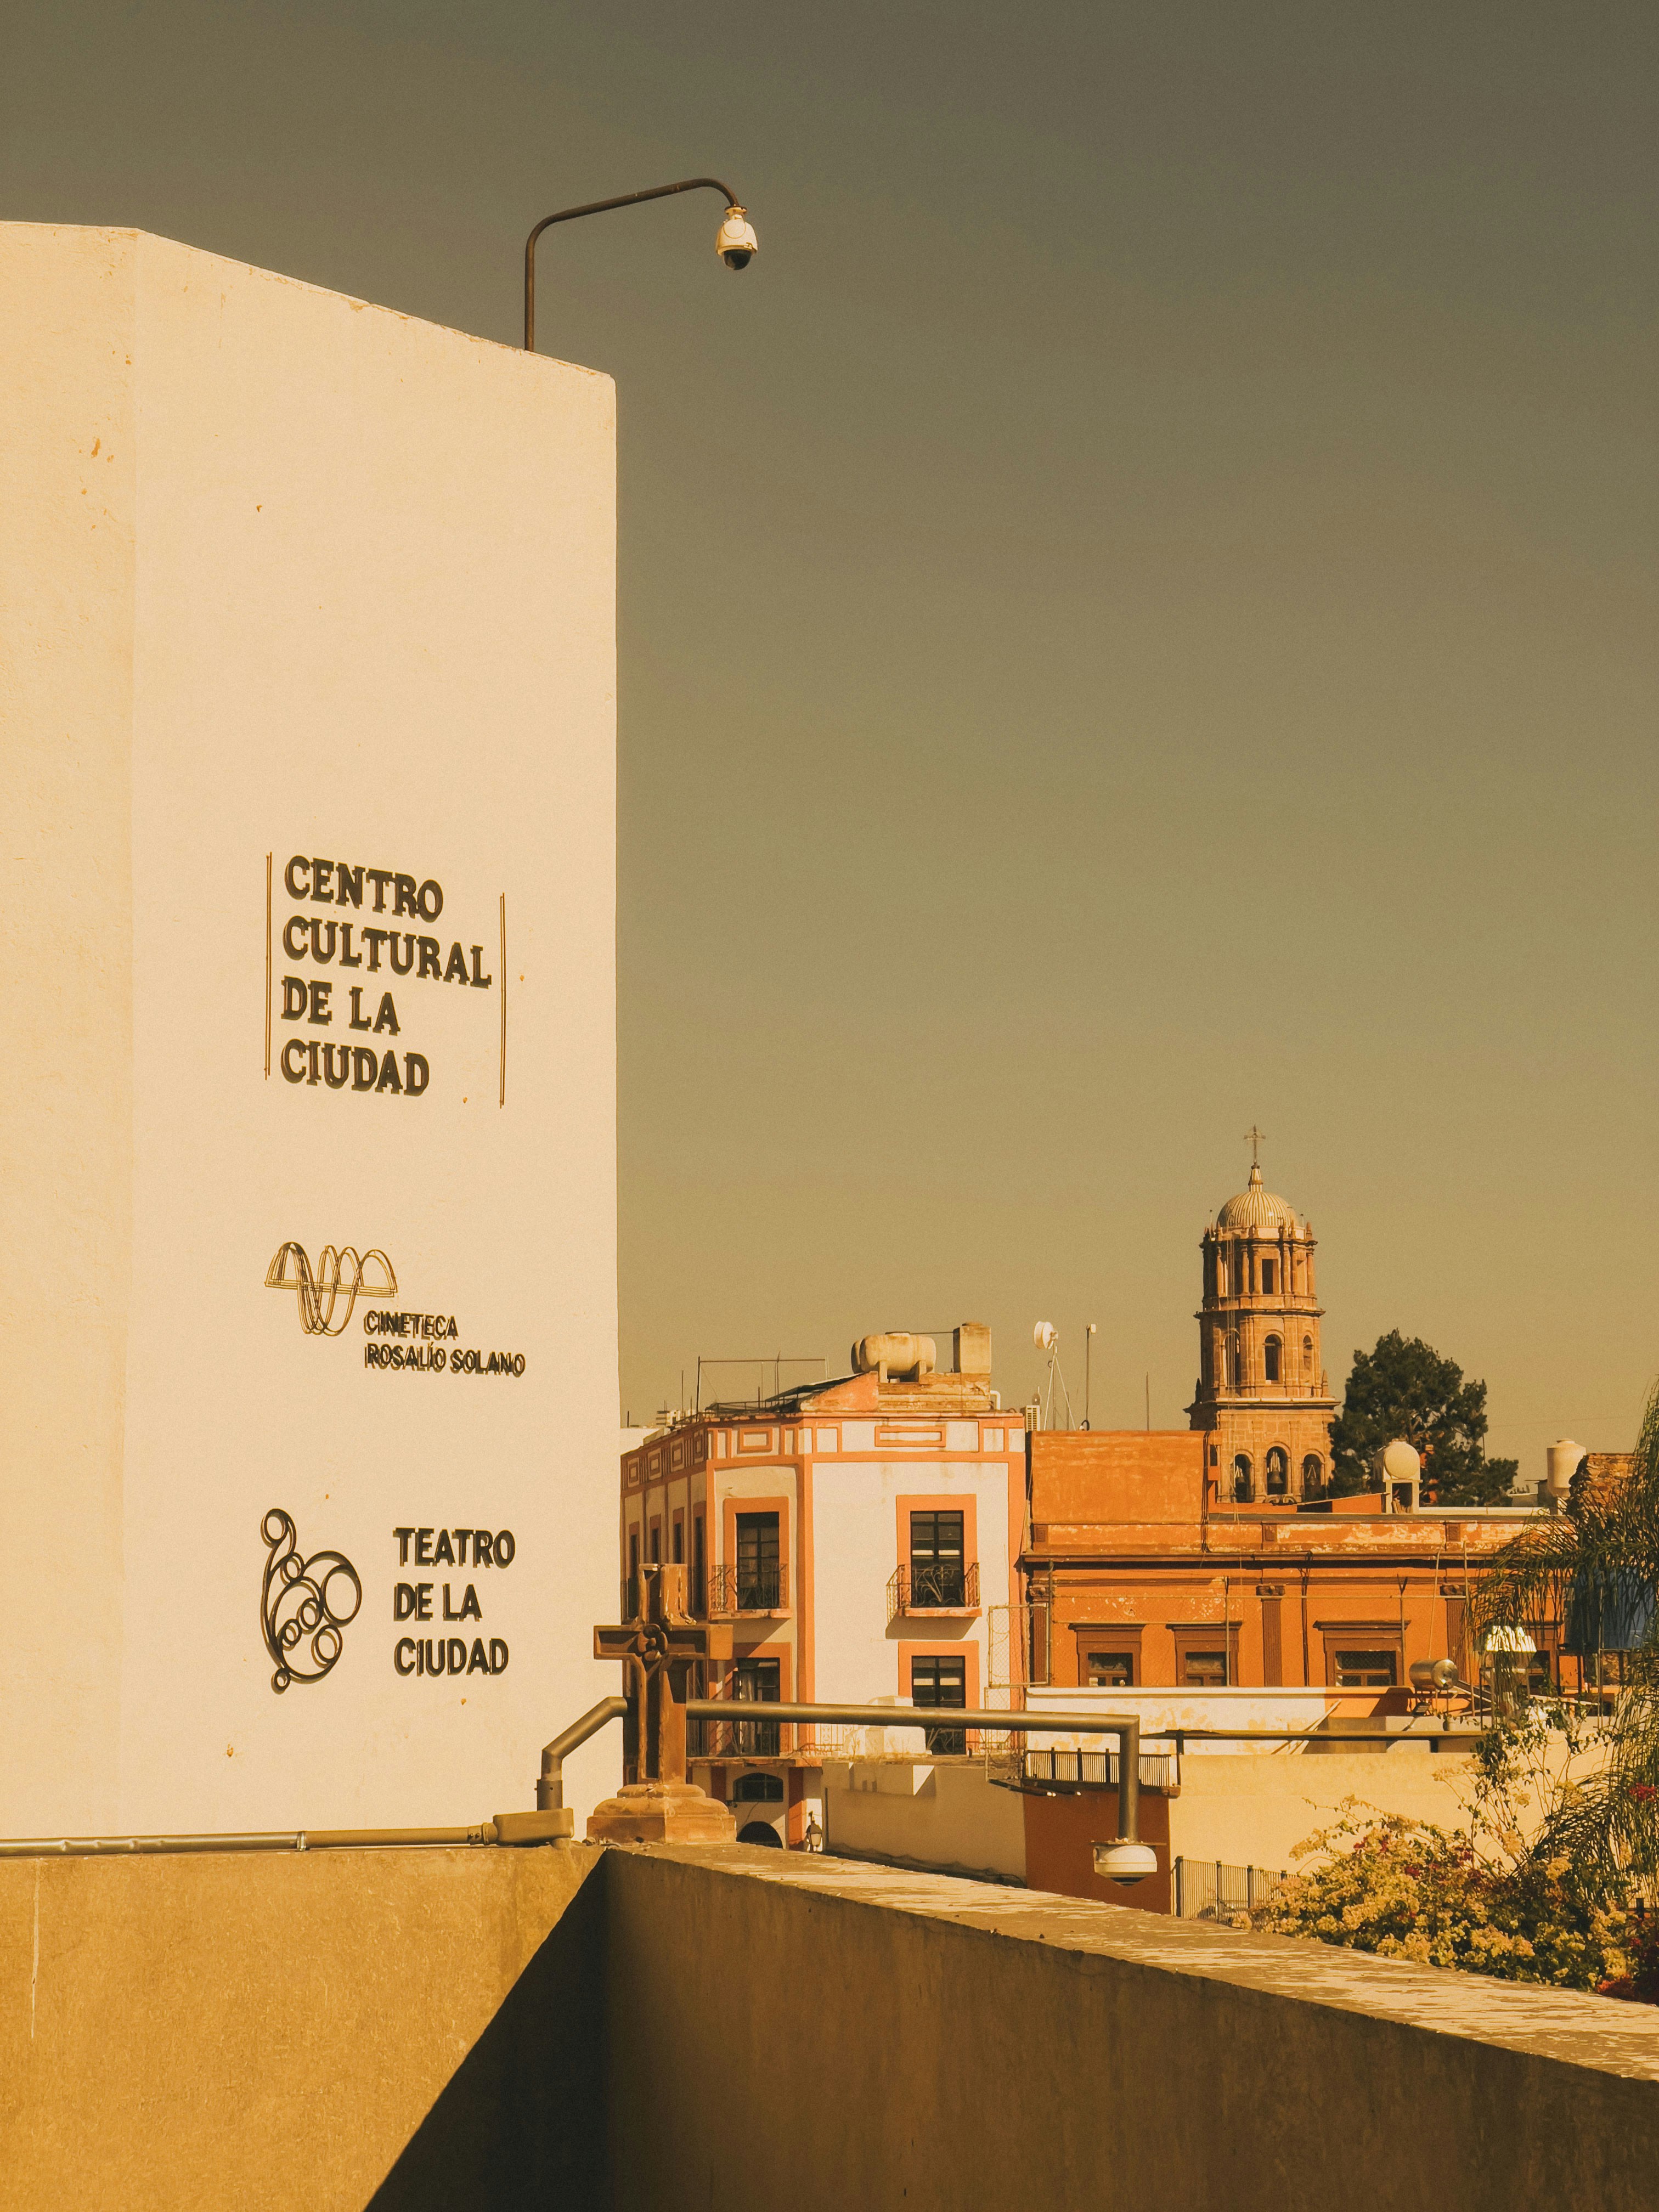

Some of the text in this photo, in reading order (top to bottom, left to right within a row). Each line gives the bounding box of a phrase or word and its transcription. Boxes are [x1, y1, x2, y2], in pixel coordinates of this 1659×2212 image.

[284, 855, 443, 923] CENTRO
[283, 916, 492, 989] CULTURAL
[281, 975, 401, 1036] DE LA
[280, 1039, 430, 1096] CIUDAD
[363, 1310, 459, 1340] CINETECA
[364, 1341, 526, 1378] ROSALÍO SOLANO
[393, 1527, 515, 1568] TEATRO
[393, 1583, 482, 1622] DE LA
[394, 1637, 509, 1677] CIUDAD
